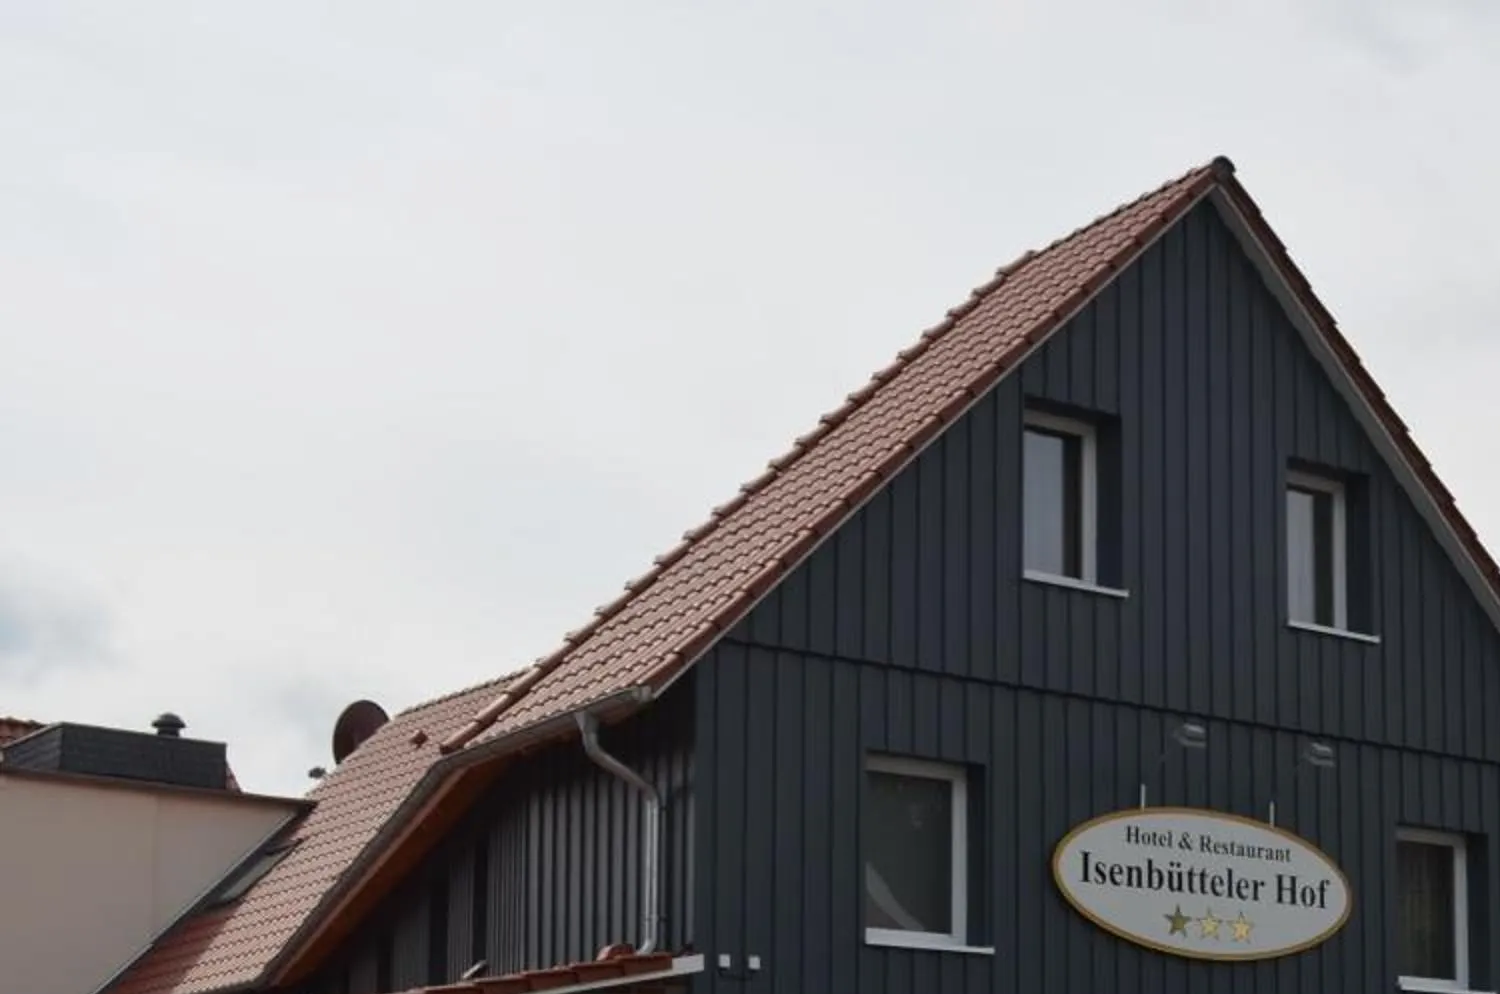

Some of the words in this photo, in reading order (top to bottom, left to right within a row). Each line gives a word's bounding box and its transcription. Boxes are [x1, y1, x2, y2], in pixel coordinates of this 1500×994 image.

[1125, 826, 1173, 849] Hotel
[1178, 833, 1193, 850] &
[1200, 835, 1291, 863] Restaurant
[1080, 851, 1265, 901] Isenbütteler
[1275, 873, 1330, 910] Hof
